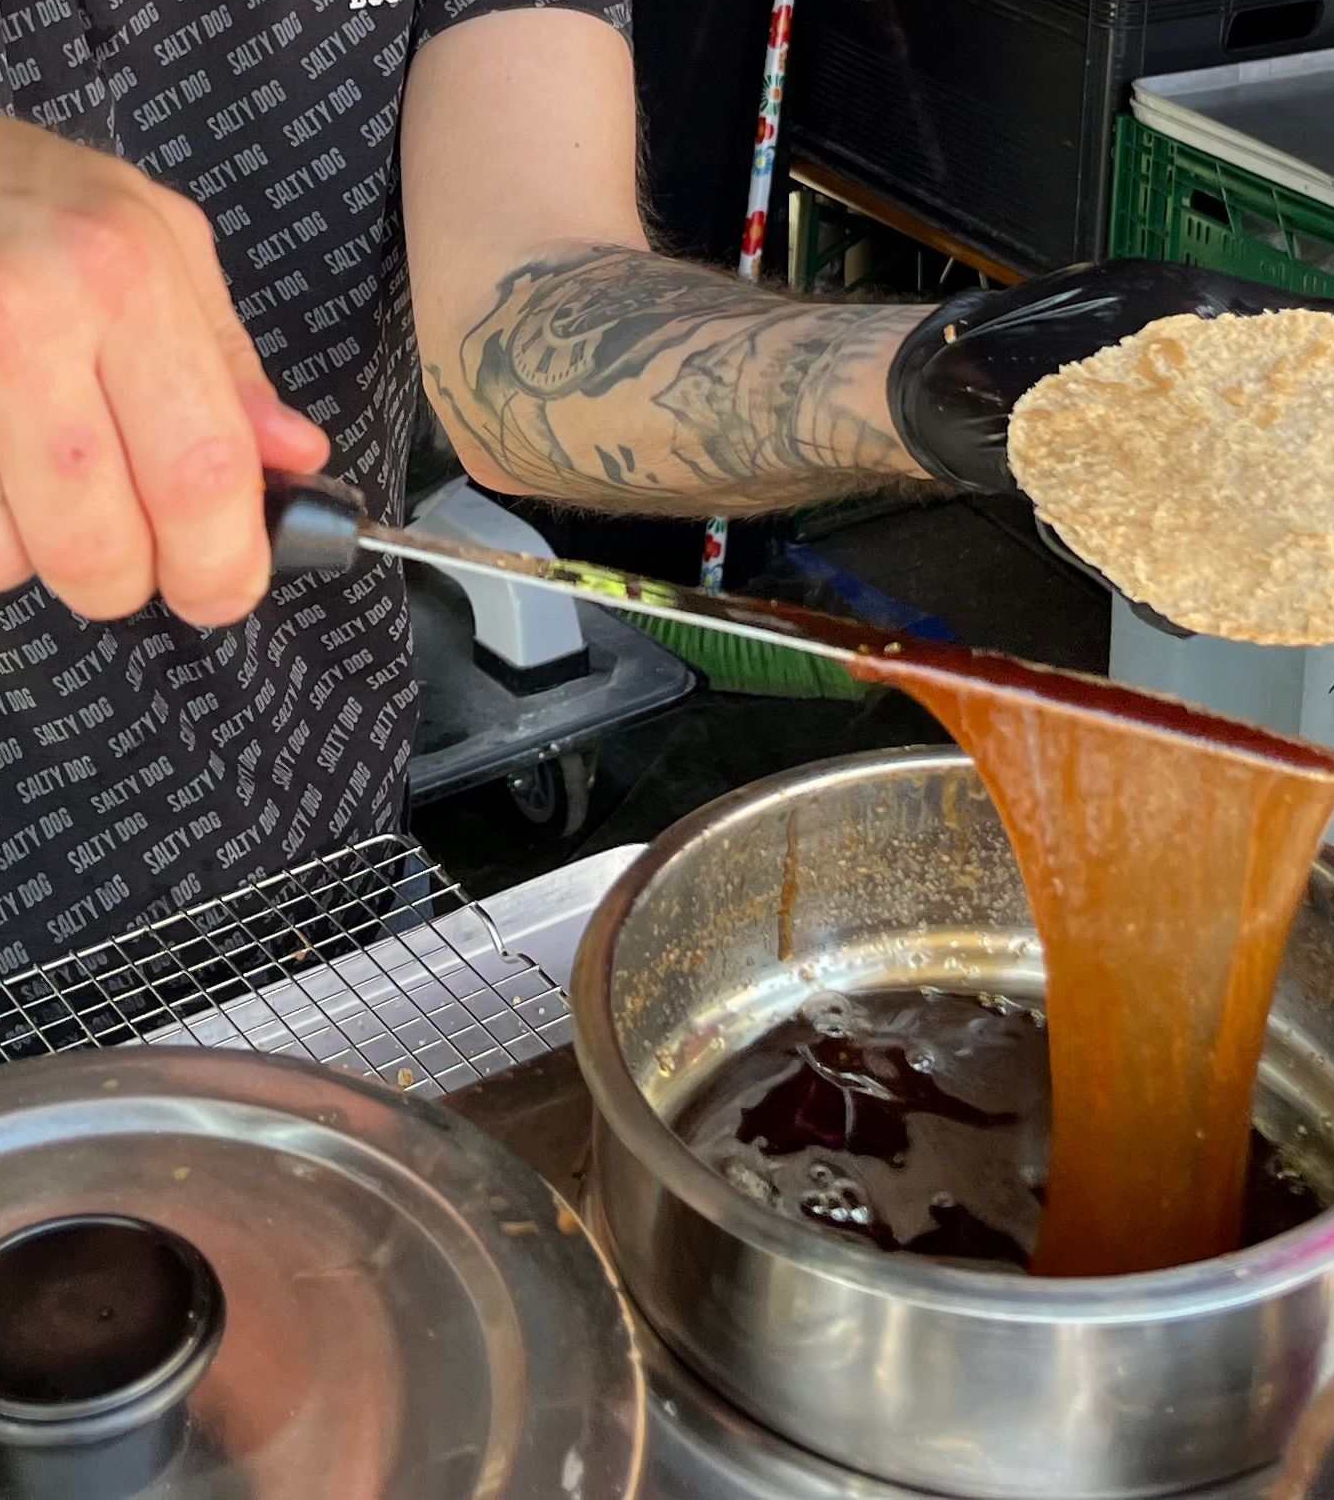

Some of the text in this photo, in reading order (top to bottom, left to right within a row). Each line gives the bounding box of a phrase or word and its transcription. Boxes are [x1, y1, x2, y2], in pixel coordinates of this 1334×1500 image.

[153, 3, 233, 67] SALTY DOG
[226, 10, 303, 76] SALTY DOG
[132, 69, 212, 132] SALTY DOG
[206, 79, 287, 141] SALTY DOG
[282, 78, 363, 148] SALTY DOG
[188, 143, 269, 202] SALTY DOG
[264, 146, 347, 210] SALTY DOG
[246, 210, 329, 270] SALTY DOG
[303, 274, 378, 334] SALTY DOG
[281, 336, 361, 392] SALTY DOG
[266, 603, 327, 668] SALTY DOG
[320, 595, 394, 652] SALTY DOG
[4, 686, 38, 713] DOG
[316, 695, 363, 774] SALTY DOG
[15, 755, 98, 805] SALTY DOG
[89, 755, 175, 815] SALTY DOG
[38, 806, 74, 841] DOG
[66, 811, 149, 875] SALTY DOG
[142, 810, 223, 876] SALTY DOG
[16, 872, 53, 909] DOG
[46, 873, 130, 944] SALTY DOG
